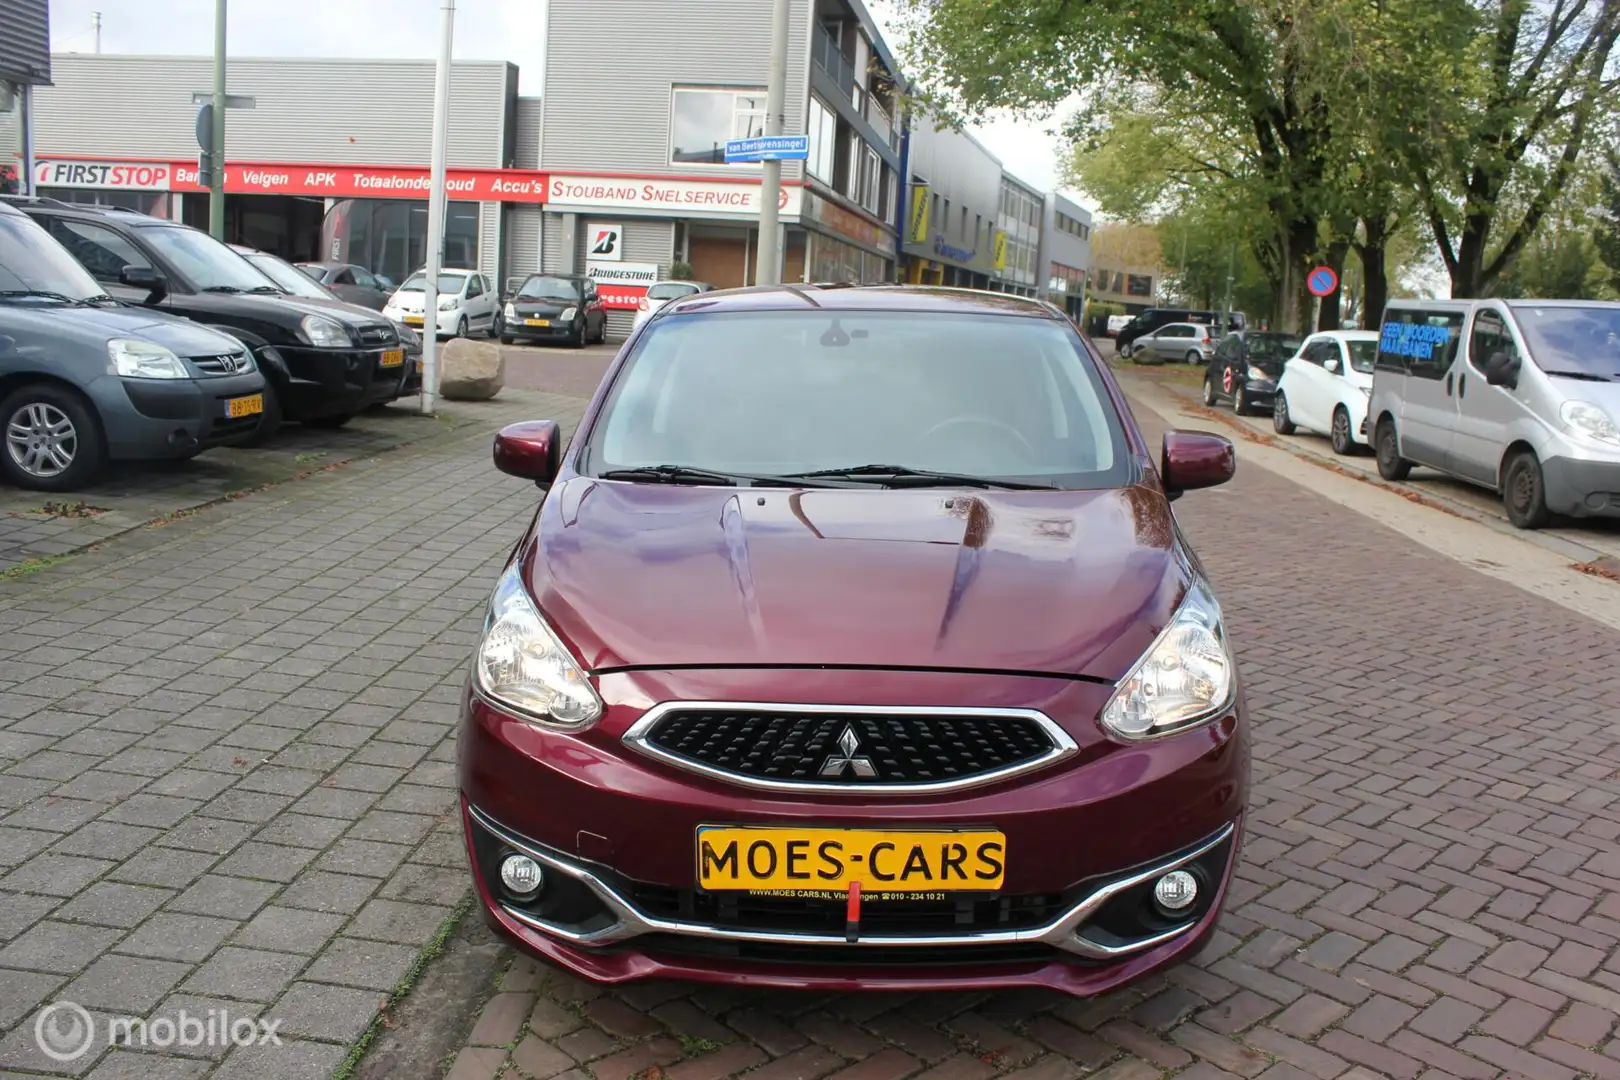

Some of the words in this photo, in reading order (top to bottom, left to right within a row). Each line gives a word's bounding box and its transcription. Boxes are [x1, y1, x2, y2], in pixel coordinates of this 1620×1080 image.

[54, 164, 167, 186] FIRSTSTOP
[243, 170, 289, 188] Velgen
[304, 172, 337, 187] APK
[353, 173, 476, 191] Totaalondeoud
[490, 178, 543, 194] Accu's
[588, 267, 656, 281] BRIDGESTONE
[702, 840, 1003, 882] MOES-CARS
[749, 889, 796, 897] WWW.MOES
[797, 890, 832, 899] CARS.NL
[833, 892, 879, 901] Vlaangen
